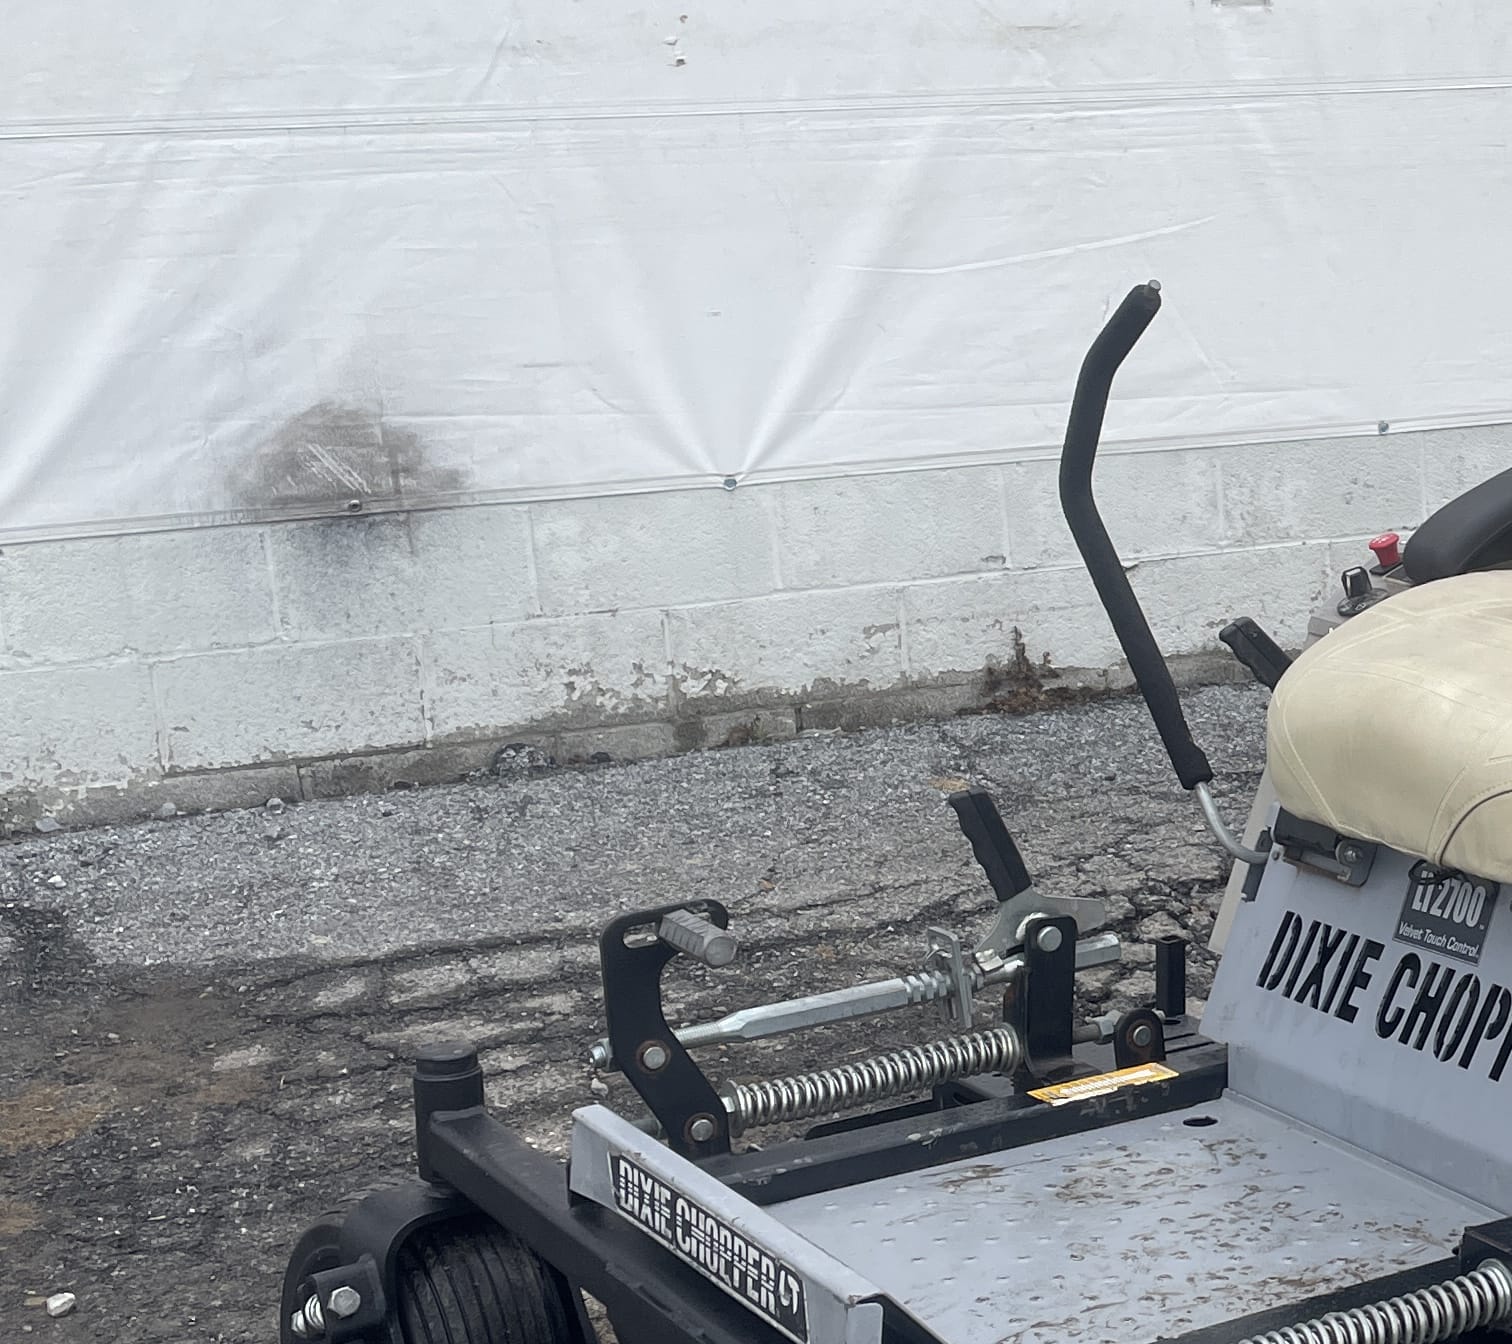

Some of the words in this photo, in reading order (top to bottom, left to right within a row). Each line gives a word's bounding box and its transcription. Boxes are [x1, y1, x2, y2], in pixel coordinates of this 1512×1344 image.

[1255, 910, 1386, 1024] DIXIE
[1398, 921, 1424, 941] Velvet
[1423, 929, 1447, 948] Touch
[1446, 936, 1480, 957] Control
[617, 1158, 673, 1240] DIXIE
[675, 1196, 778, 1317] CHOPPER
